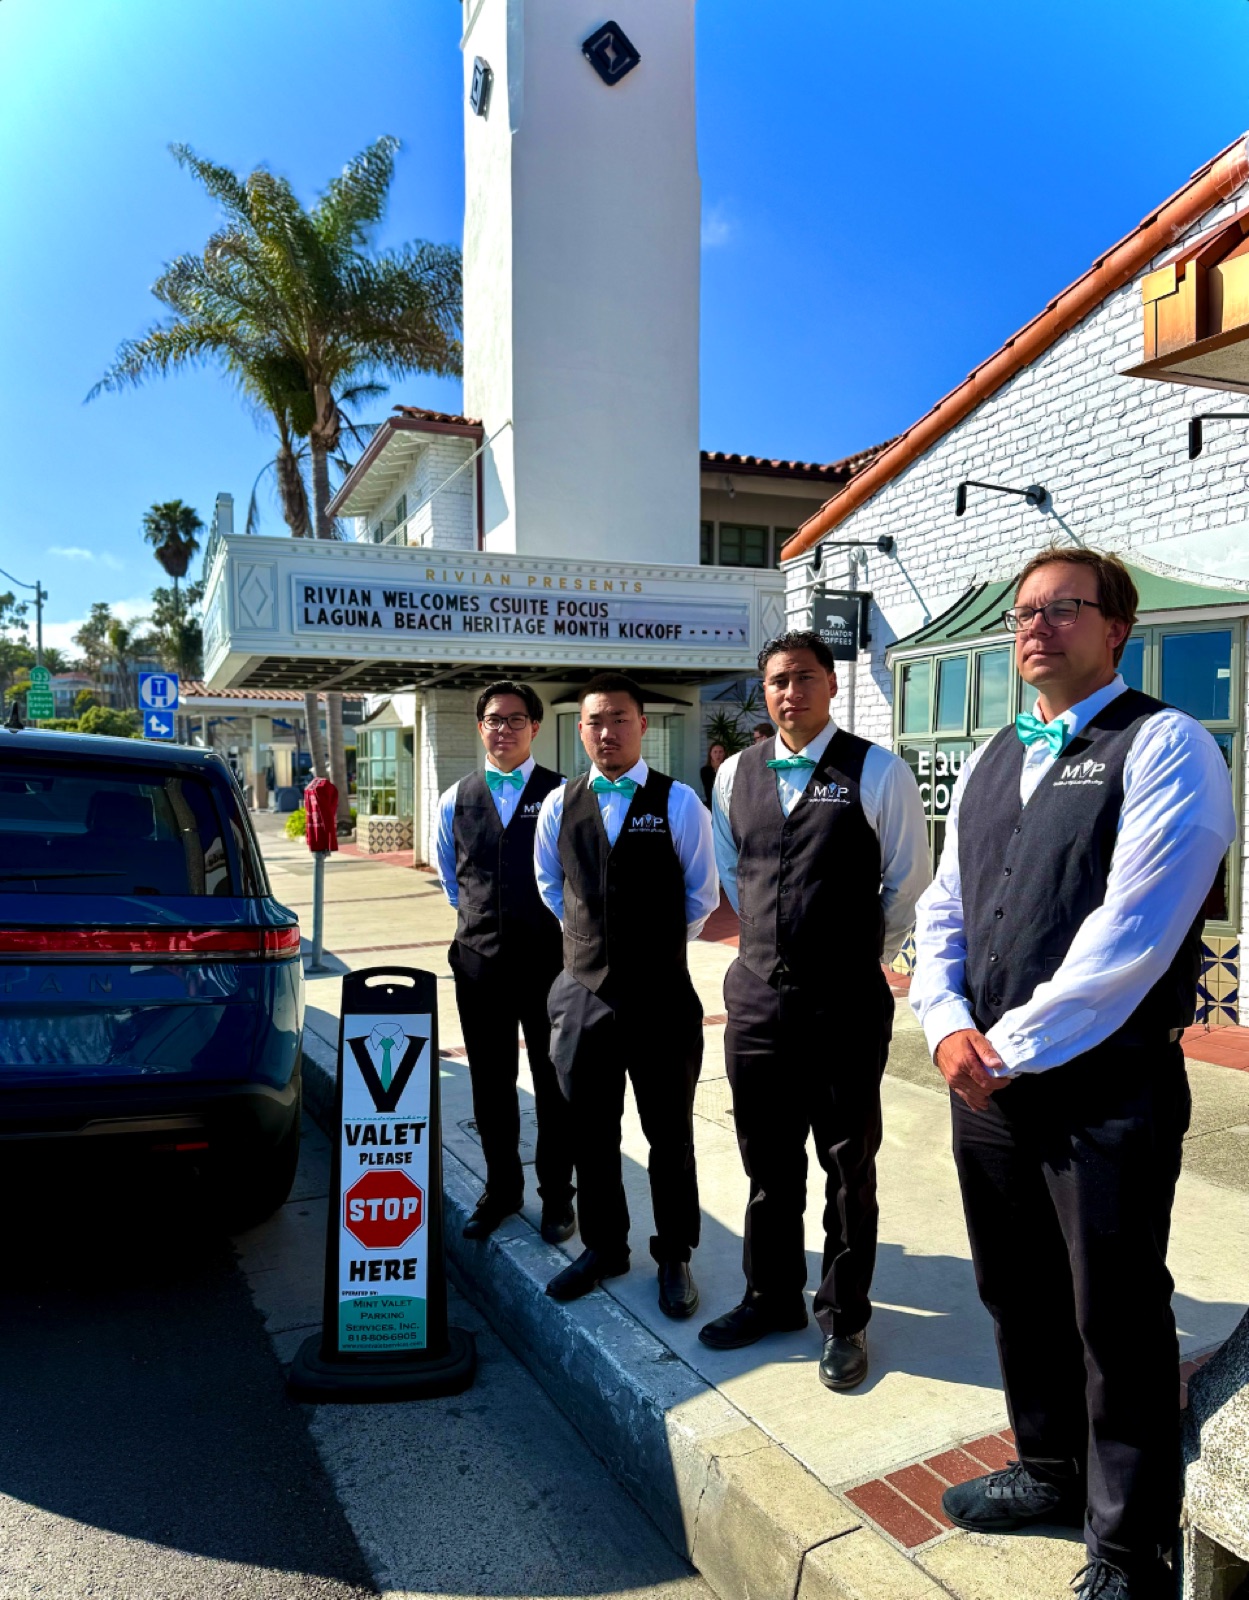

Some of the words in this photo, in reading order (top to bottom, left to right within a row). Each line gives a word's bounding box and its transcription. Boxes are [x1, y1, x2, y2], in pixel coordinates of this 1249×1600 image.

[426, 569, 511, 586] RIVIAN
[528, 576, 643, 593] PRESENTS
[304, 586, 371, 607] RIVIAN
[383, 590, 480, 612] WELCOMES
[490, 597, 549, 616] CSUITE
[557, 601, 609, 618] FOCUS
[304, 607, 382, 628] LAGUNA
[394, 612, 452, 631] BEACH
[463, 616, 546, 635] HERITAGE
[554, 619, 609, 638] MONTH
[619, 623, 682, 640] KICKOFF
[819, 628, 853, 638] EQUATOR
[1060, 759, 1106, 779] MVP
[344, 1122, 427, 1146] VALET
[359, 1151, 413, 1166] PLEASE
[349, 1196, 419, 1222] STOP
[349, 1258, 418, 1282] HERE
